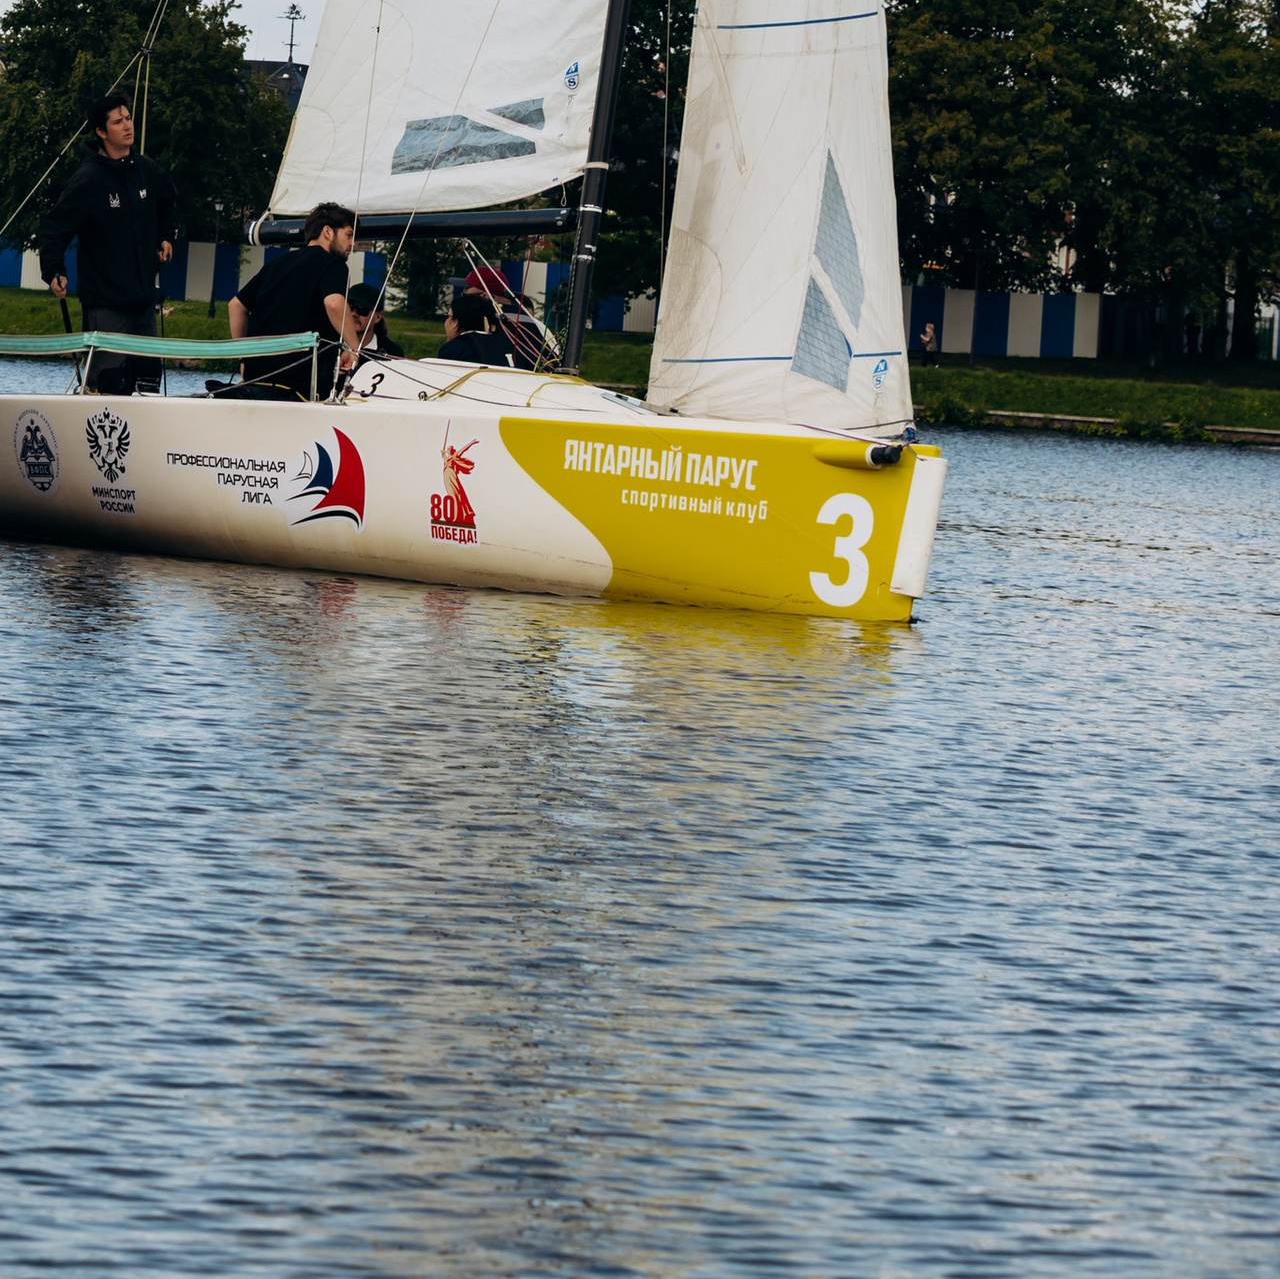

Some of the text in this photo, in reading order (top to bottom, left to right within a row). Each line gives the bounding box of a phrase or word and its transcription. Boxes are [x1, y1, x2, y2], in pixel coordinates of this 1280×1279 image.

[360, 372, 385, 398] 3
[166, 453, 286, 473] ПРОФЕССИОНАЛЬНАЯ
[563, 439, 758, 491] ЯНТАРНЫЙ ПАРУС
[217, 473, 279, 489] ПАРУСНАЯ
[92, 486, 136, 501] МИНСПОРТ
[242, 491, 272, 504] ЛИГА
[100, 500, 135, 513] РОССИИ
[431, 493, 455, 522] 80
[621, 489, 768, 524] спортивный клуб
[431, 525, 477, 544] ПОБЕДА!
[809, 492, 874, 607] 3
